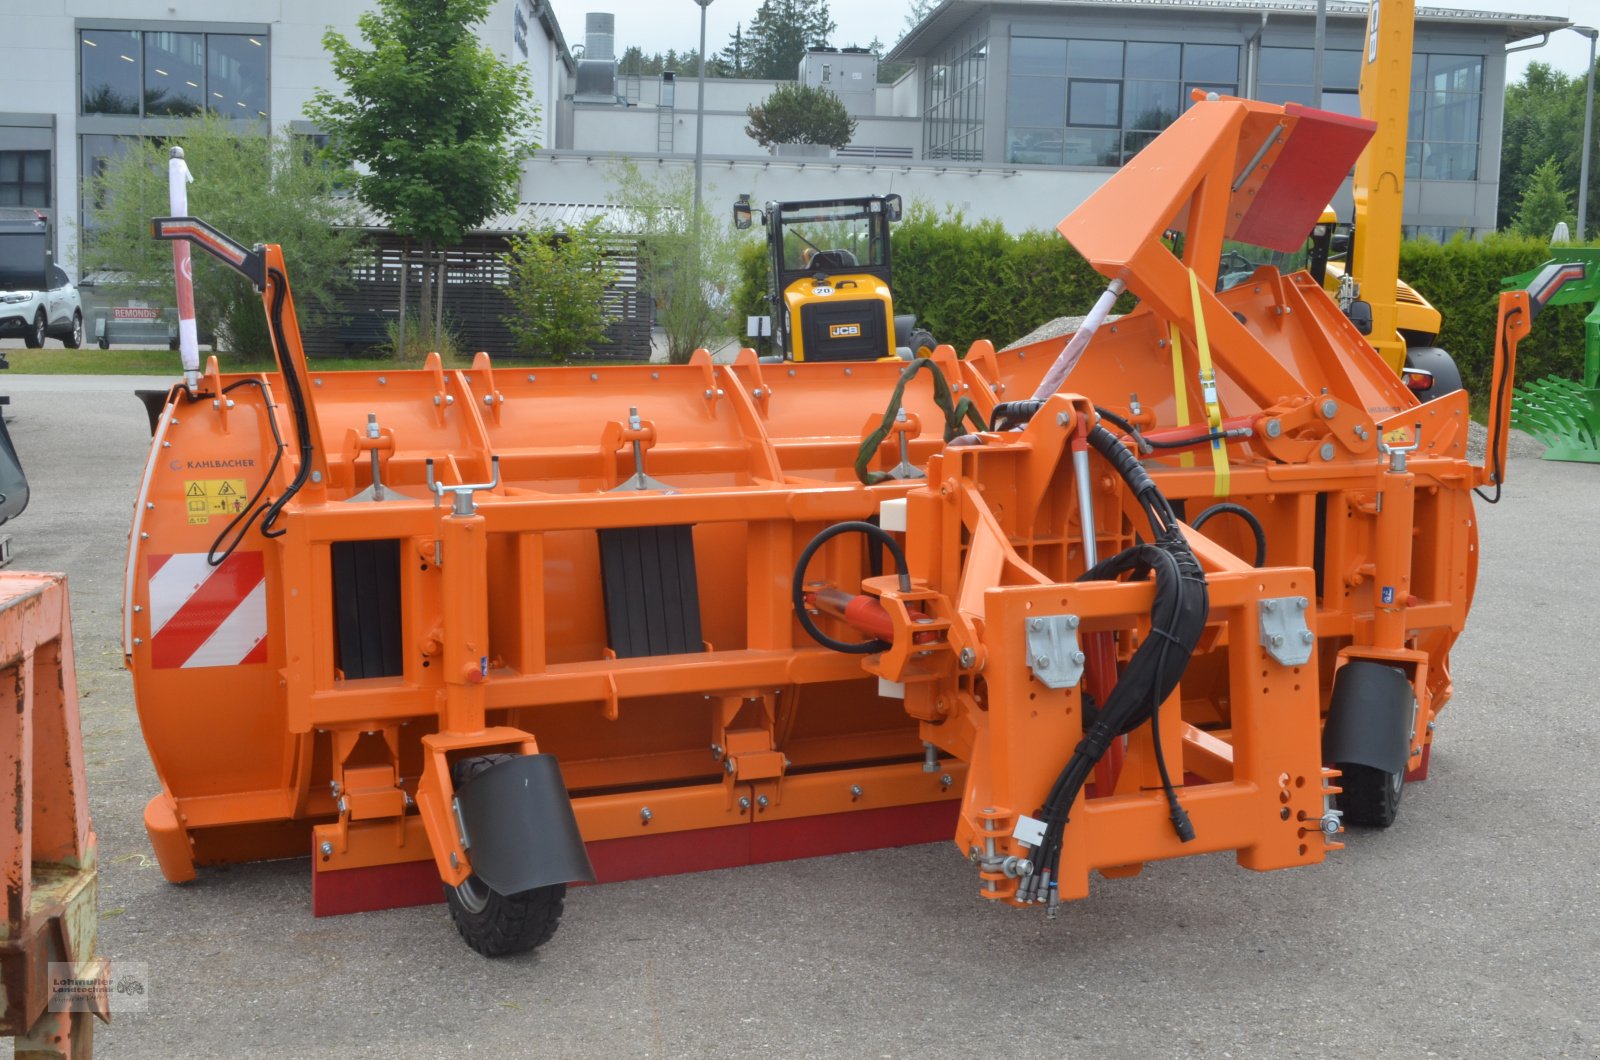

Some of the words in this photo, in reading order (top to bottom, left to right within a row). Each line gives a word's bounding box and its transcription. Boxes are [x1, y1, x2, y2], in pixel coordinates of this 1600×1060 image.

[1368, 0, 1379, 64] CB
[832, 326, 858, 335] JCB
[187, 460, 254, 468] KAHLBACHER
